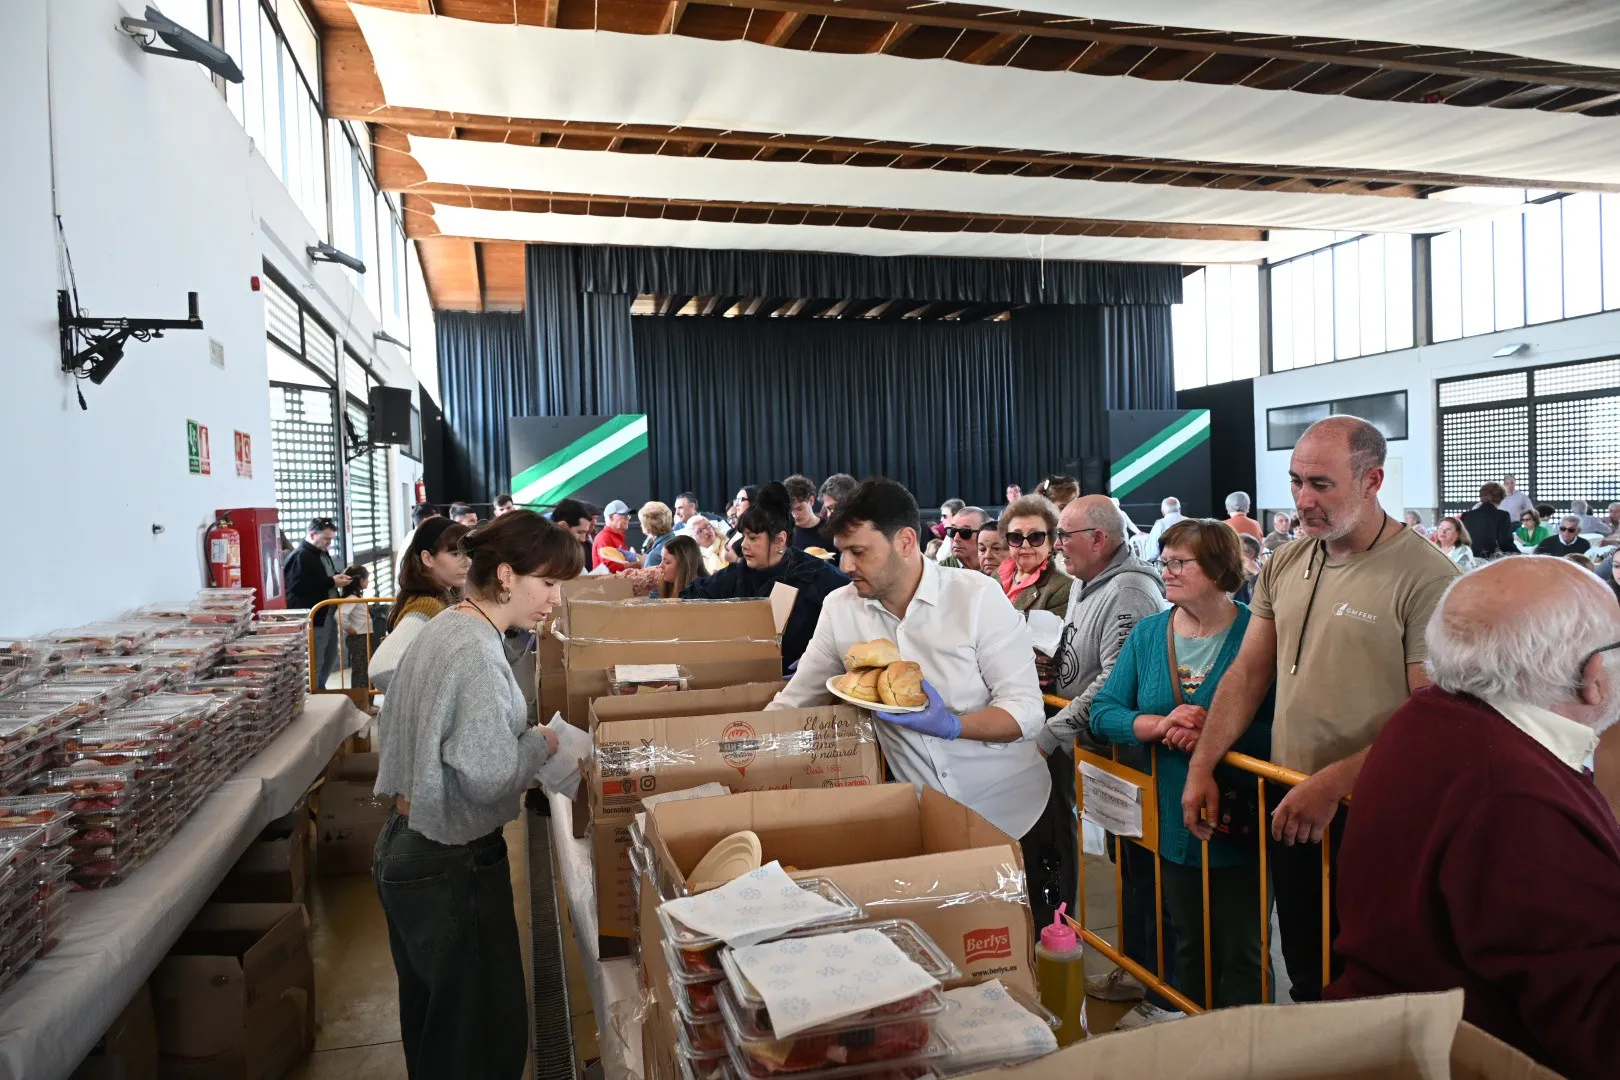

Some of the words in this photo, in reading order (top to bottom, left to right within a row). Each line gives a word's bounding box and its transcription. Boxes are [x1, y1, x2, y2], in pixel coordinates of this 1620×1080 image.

[804, 716, 818, 731] El
[819, 715, 851, 730] sabor
[820, 746, 858, 759] natural
[966, 934, 1008, 953] Berlys
[972, 965, 1018, 977] www.berlys.es
